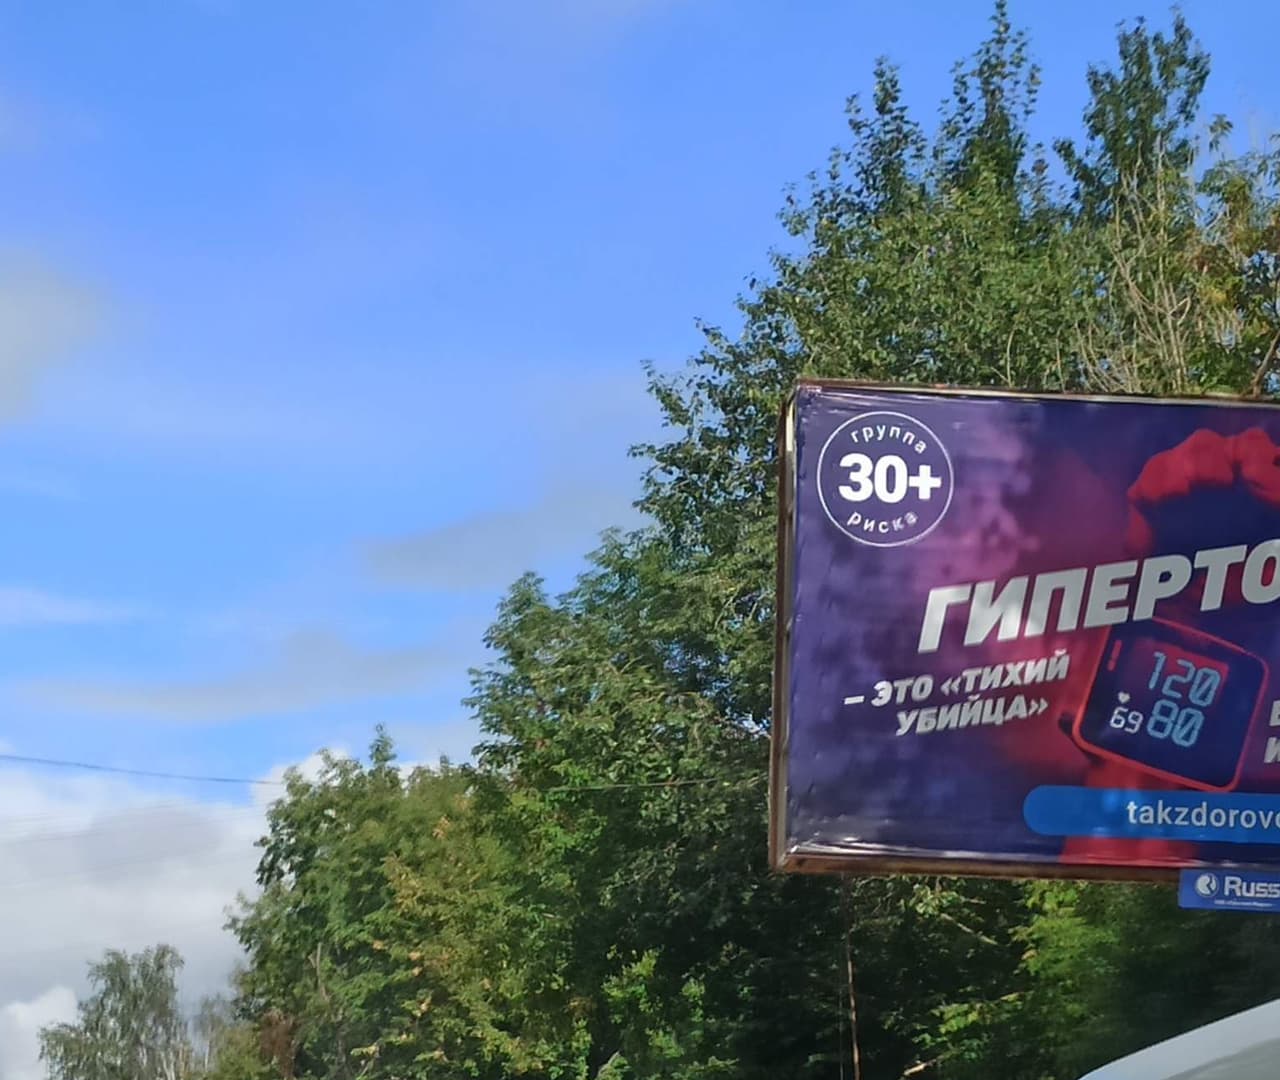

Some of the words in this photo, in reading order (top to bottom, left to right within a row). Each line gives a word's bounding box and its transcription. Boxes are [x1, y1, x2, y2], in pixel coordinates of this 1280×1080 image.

[850, 424, 927, 454] группа
[838, 453, 942, 503] 30+
[847, 511, 918, 533] риска
[871, 675, 933, 707] ЭТО
[940, 648, 1071, 697] «ТИХИЙ
[1148, 651, 1220, 707] 120
[895, 694, 1048, 737] УБИЙЦА»
[1110, 706, 1143, 734] 69
[1147, 699, 1205, 747] 80
